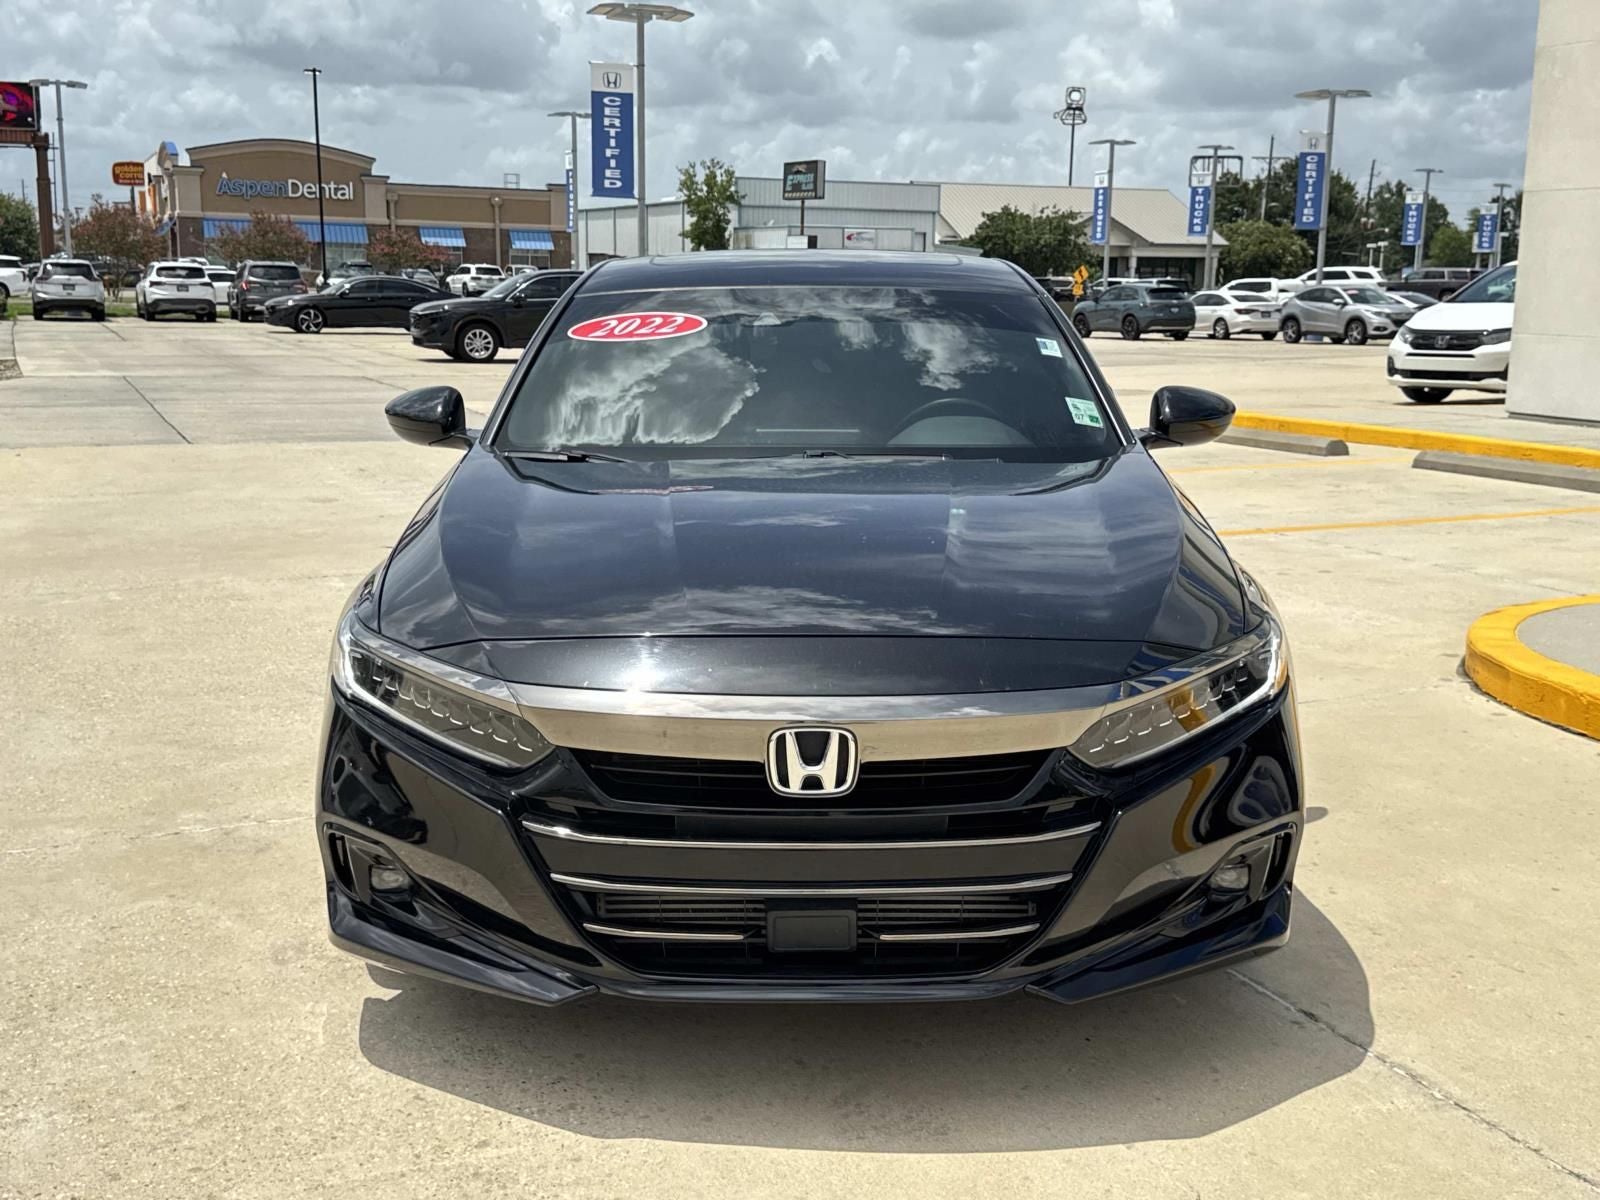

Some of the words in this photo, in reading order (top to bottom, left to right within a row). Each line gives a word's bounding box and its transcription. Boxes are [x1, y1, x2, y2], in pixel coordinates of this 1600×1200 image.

[602, 96, 623, 189] CERTIFIED
[1193, 188, 1205, 232] TRUCKS
[1302, 155, 1319, 223] CERTIFIED
[1406, 204, 1418, 242] TRUCKS
[587, 316, 686, 337] 2022
